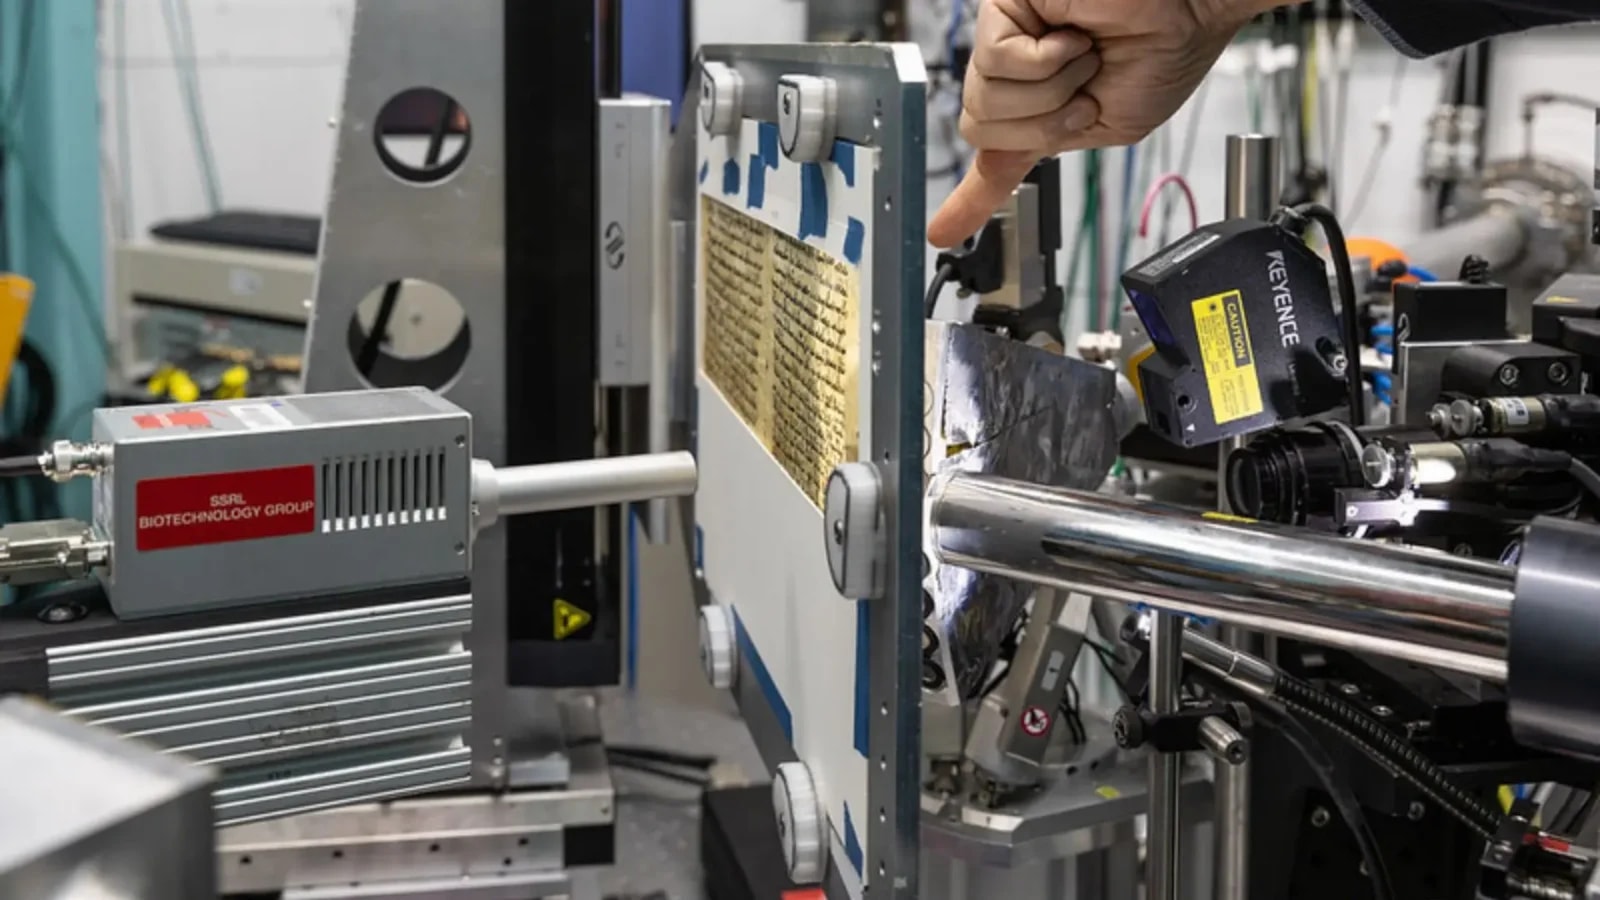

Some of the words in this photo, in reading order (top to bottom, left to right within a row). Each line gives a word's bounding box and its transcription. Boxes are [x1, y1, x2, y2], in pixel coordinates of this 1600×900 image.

[1265, 250, 1300, 348] KEYENCE
[1226, 302, 1247, 360] CAUTION
[139, 506, 261, 529] BIOTECHNOLOGY
[264, 500, 314, 517] GROUP
[210, 493, 246, 507] SSRL
